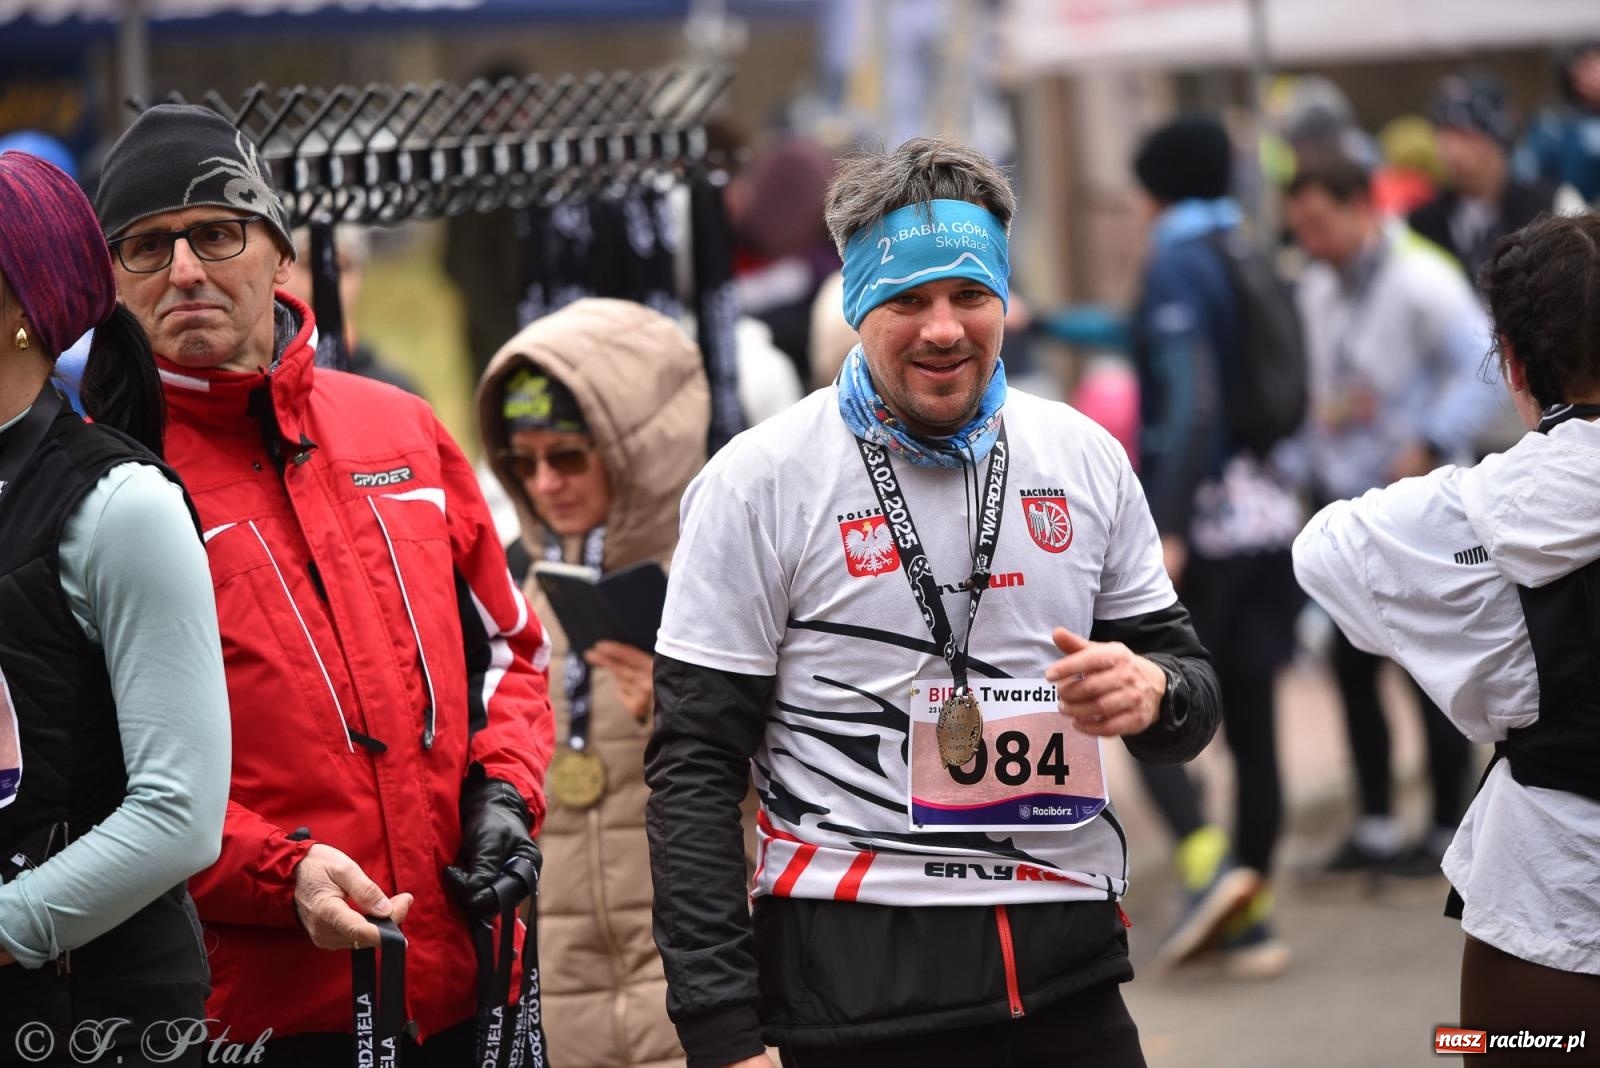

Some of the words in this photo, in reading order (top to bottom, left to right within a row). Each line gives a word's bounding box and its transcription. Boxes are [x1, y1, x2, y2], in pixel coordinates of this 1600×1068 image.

[951, 220, 989, 239] GÓRA
[935, 234, 988, 251] SkyRace
[354, 467, 411, 486] SPYDER
[979, 441, 1006, 547] TWARDZIELA
[1020, 487, 1065, 497] RACIBÓRZ
[837, 507, 882, 523] POLSK
[1453, 544, 1490, 565] PUM
[980, 685, 1060, 703] Twardzi
[1032, 805, 1073, 816] Racibórz
